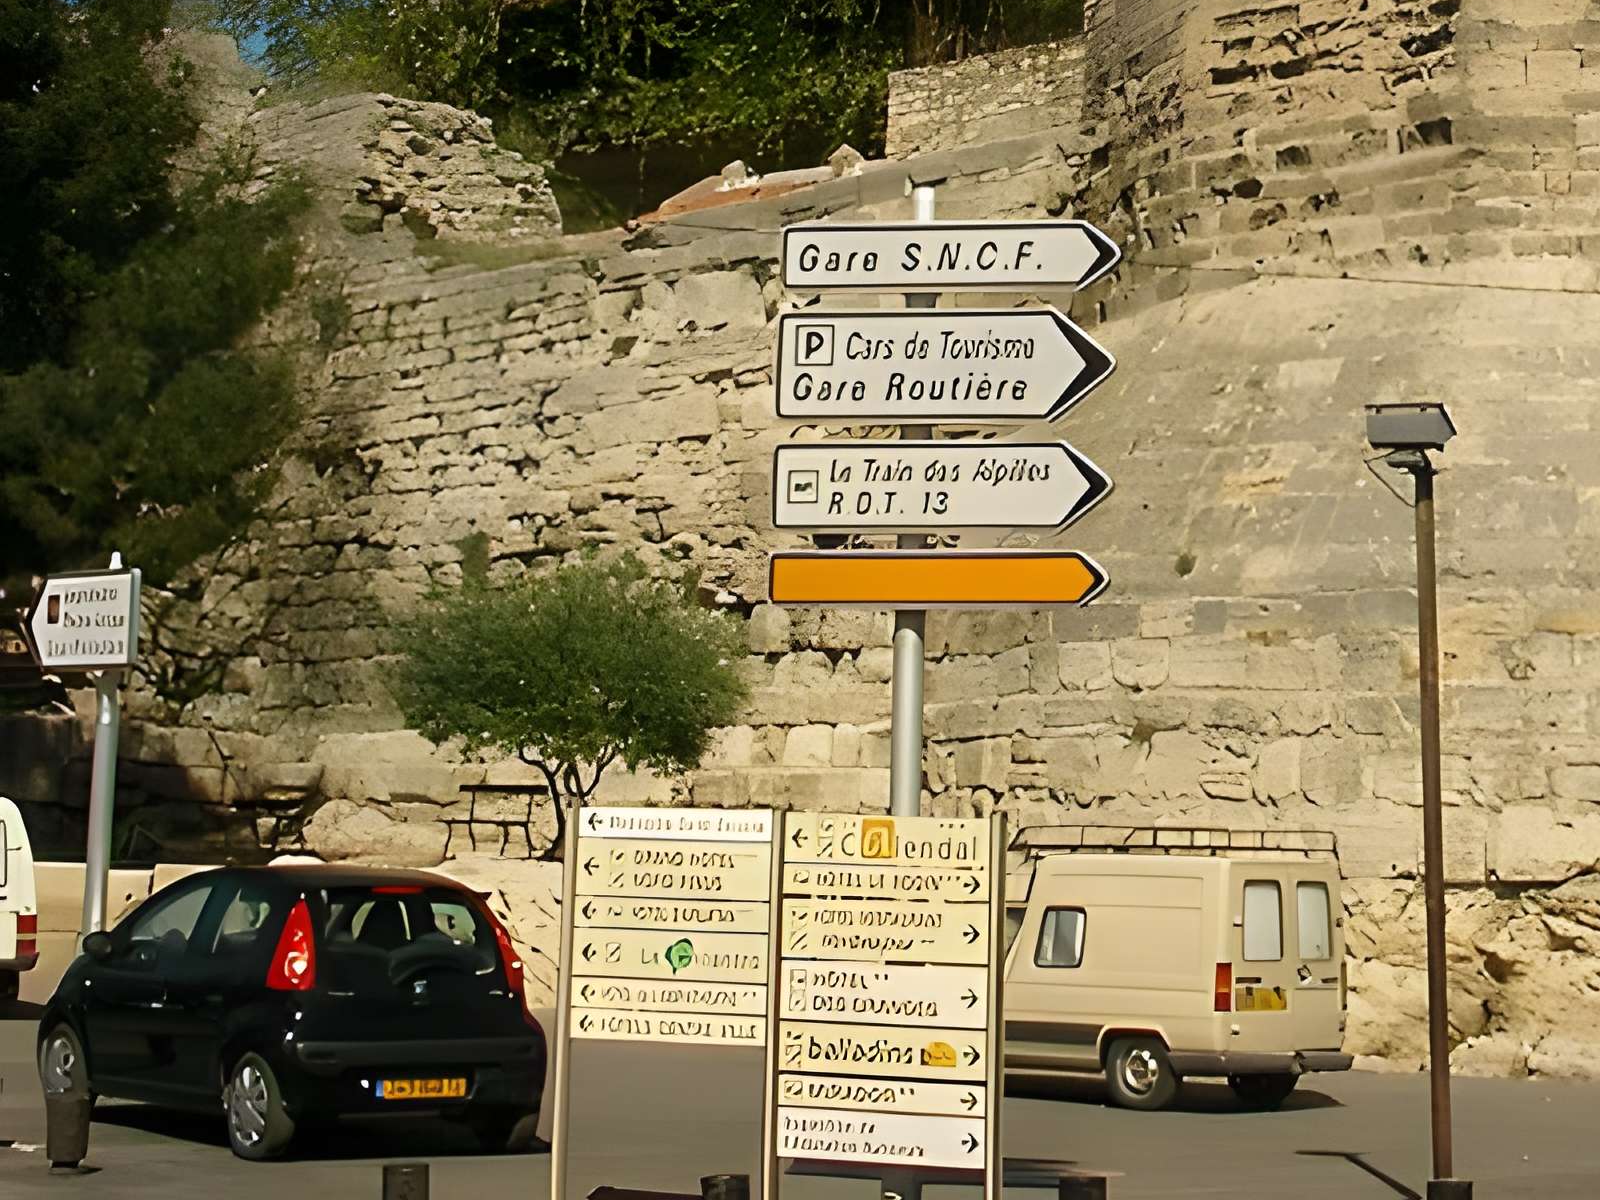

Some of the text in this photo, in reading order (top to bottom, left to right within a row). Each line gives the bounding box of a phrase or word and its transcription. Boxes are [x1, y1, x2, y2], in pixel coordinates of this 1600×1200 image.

[799, 241, 1042, 272] Gare S.N.C.F.
[846, 331, 895, 361] Cars
[904, 330, 930, 360] de
[793, 372, 1028, 401] Gare Routière
[922, 491, 949, 515] 13
